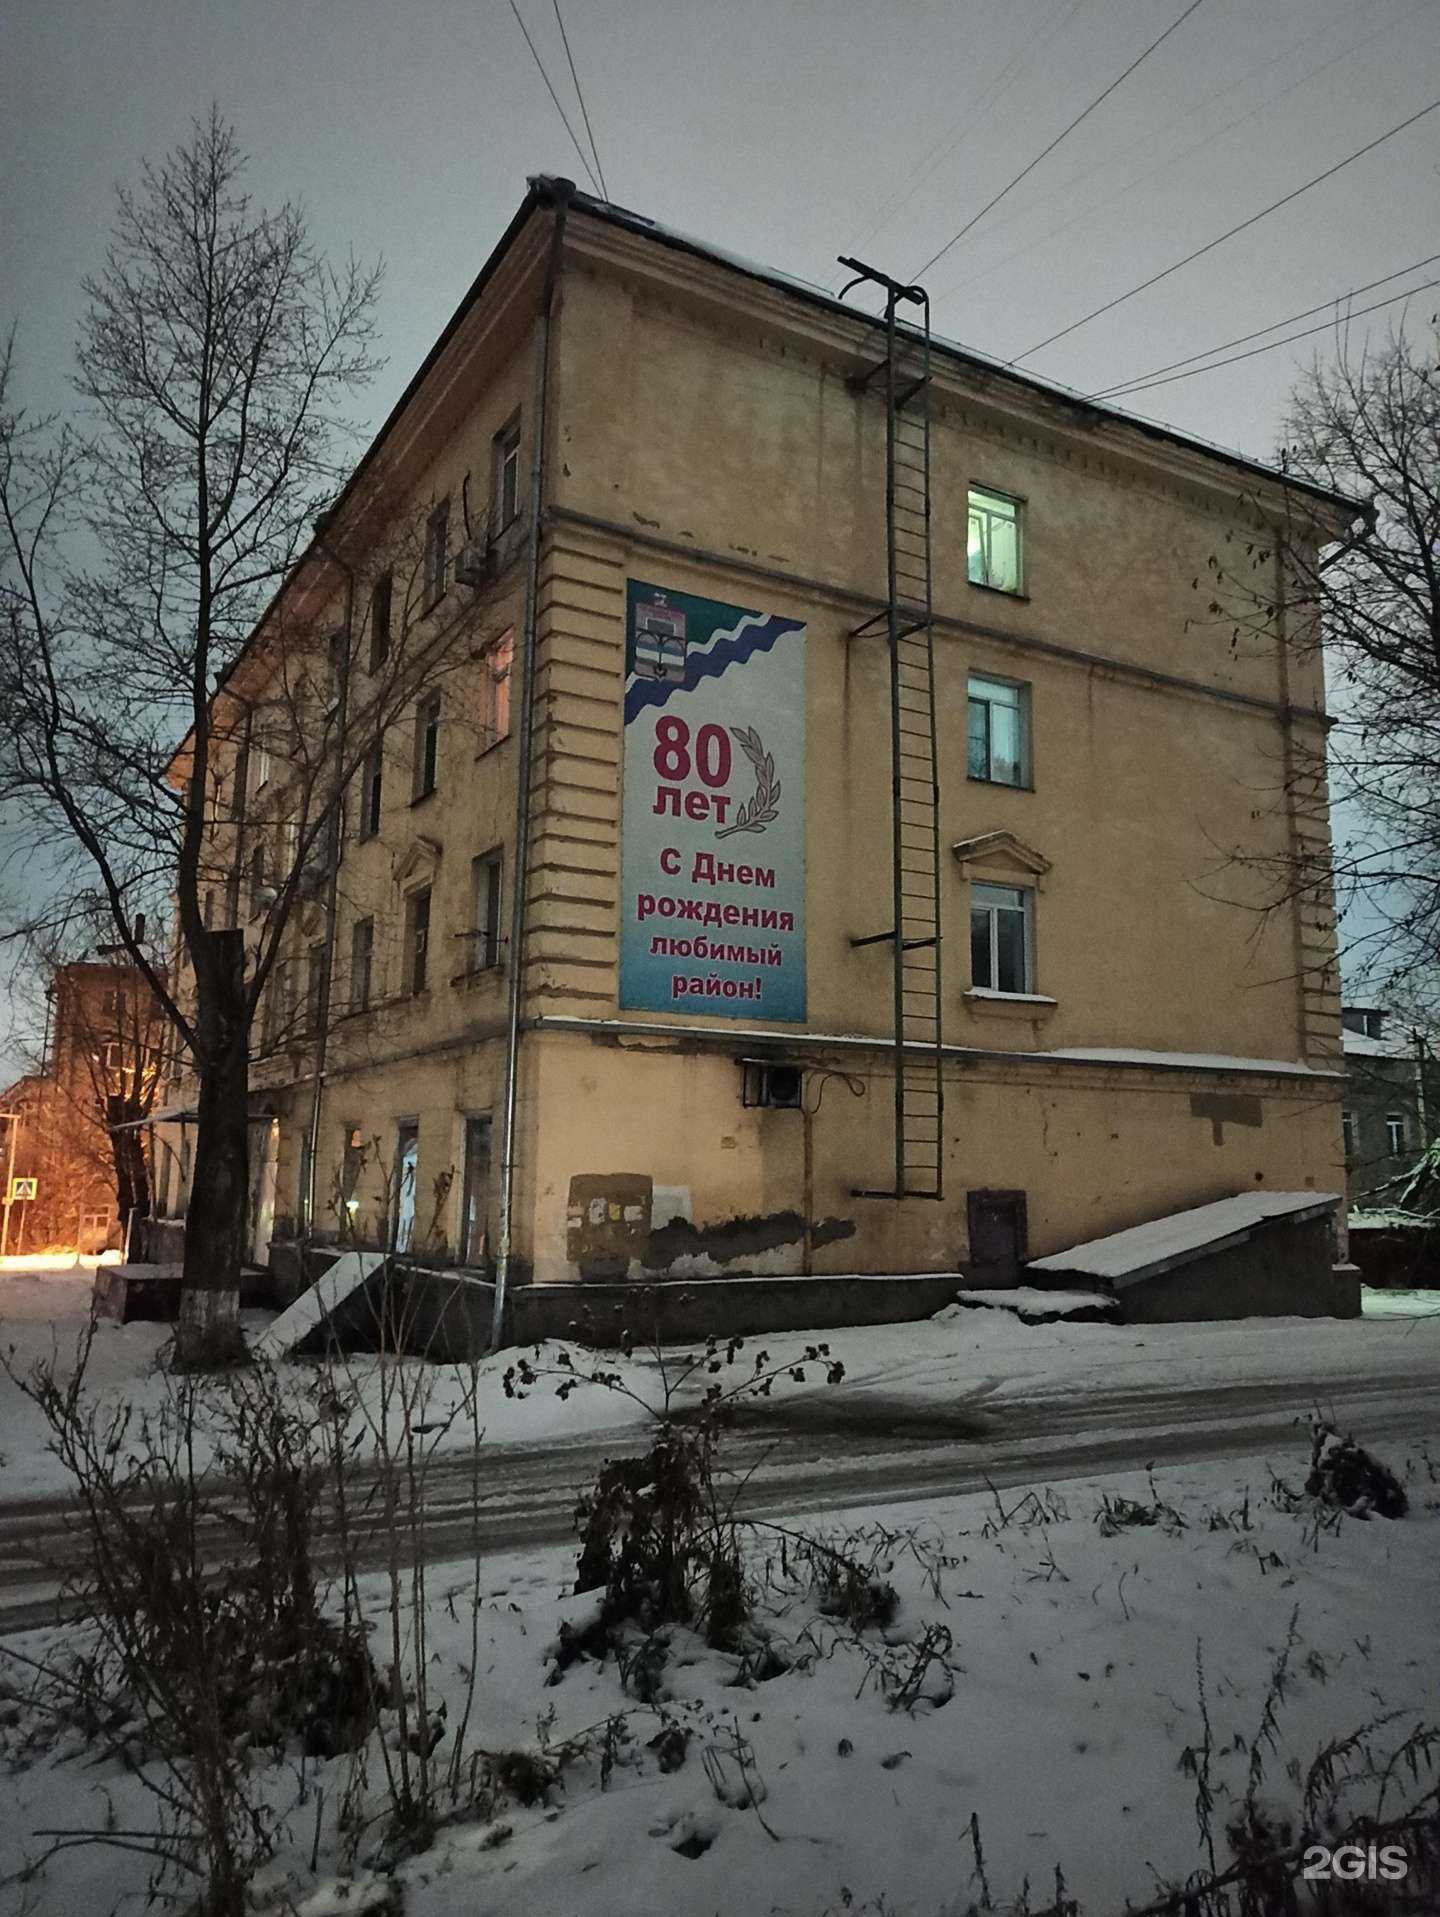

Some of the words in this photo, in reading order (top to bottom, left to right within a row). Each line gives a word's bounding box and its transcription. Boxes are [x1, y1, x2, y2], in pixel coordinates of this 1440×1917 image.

[653, 715, 731, 788] 80
[652, 785, 731, 824] лет
[691, 852, 775, 888] Днем
[637, 893, 794, 931] рождения
[649, 935, 783, 966] любимый
[672, 973, 762, 1000] район!
